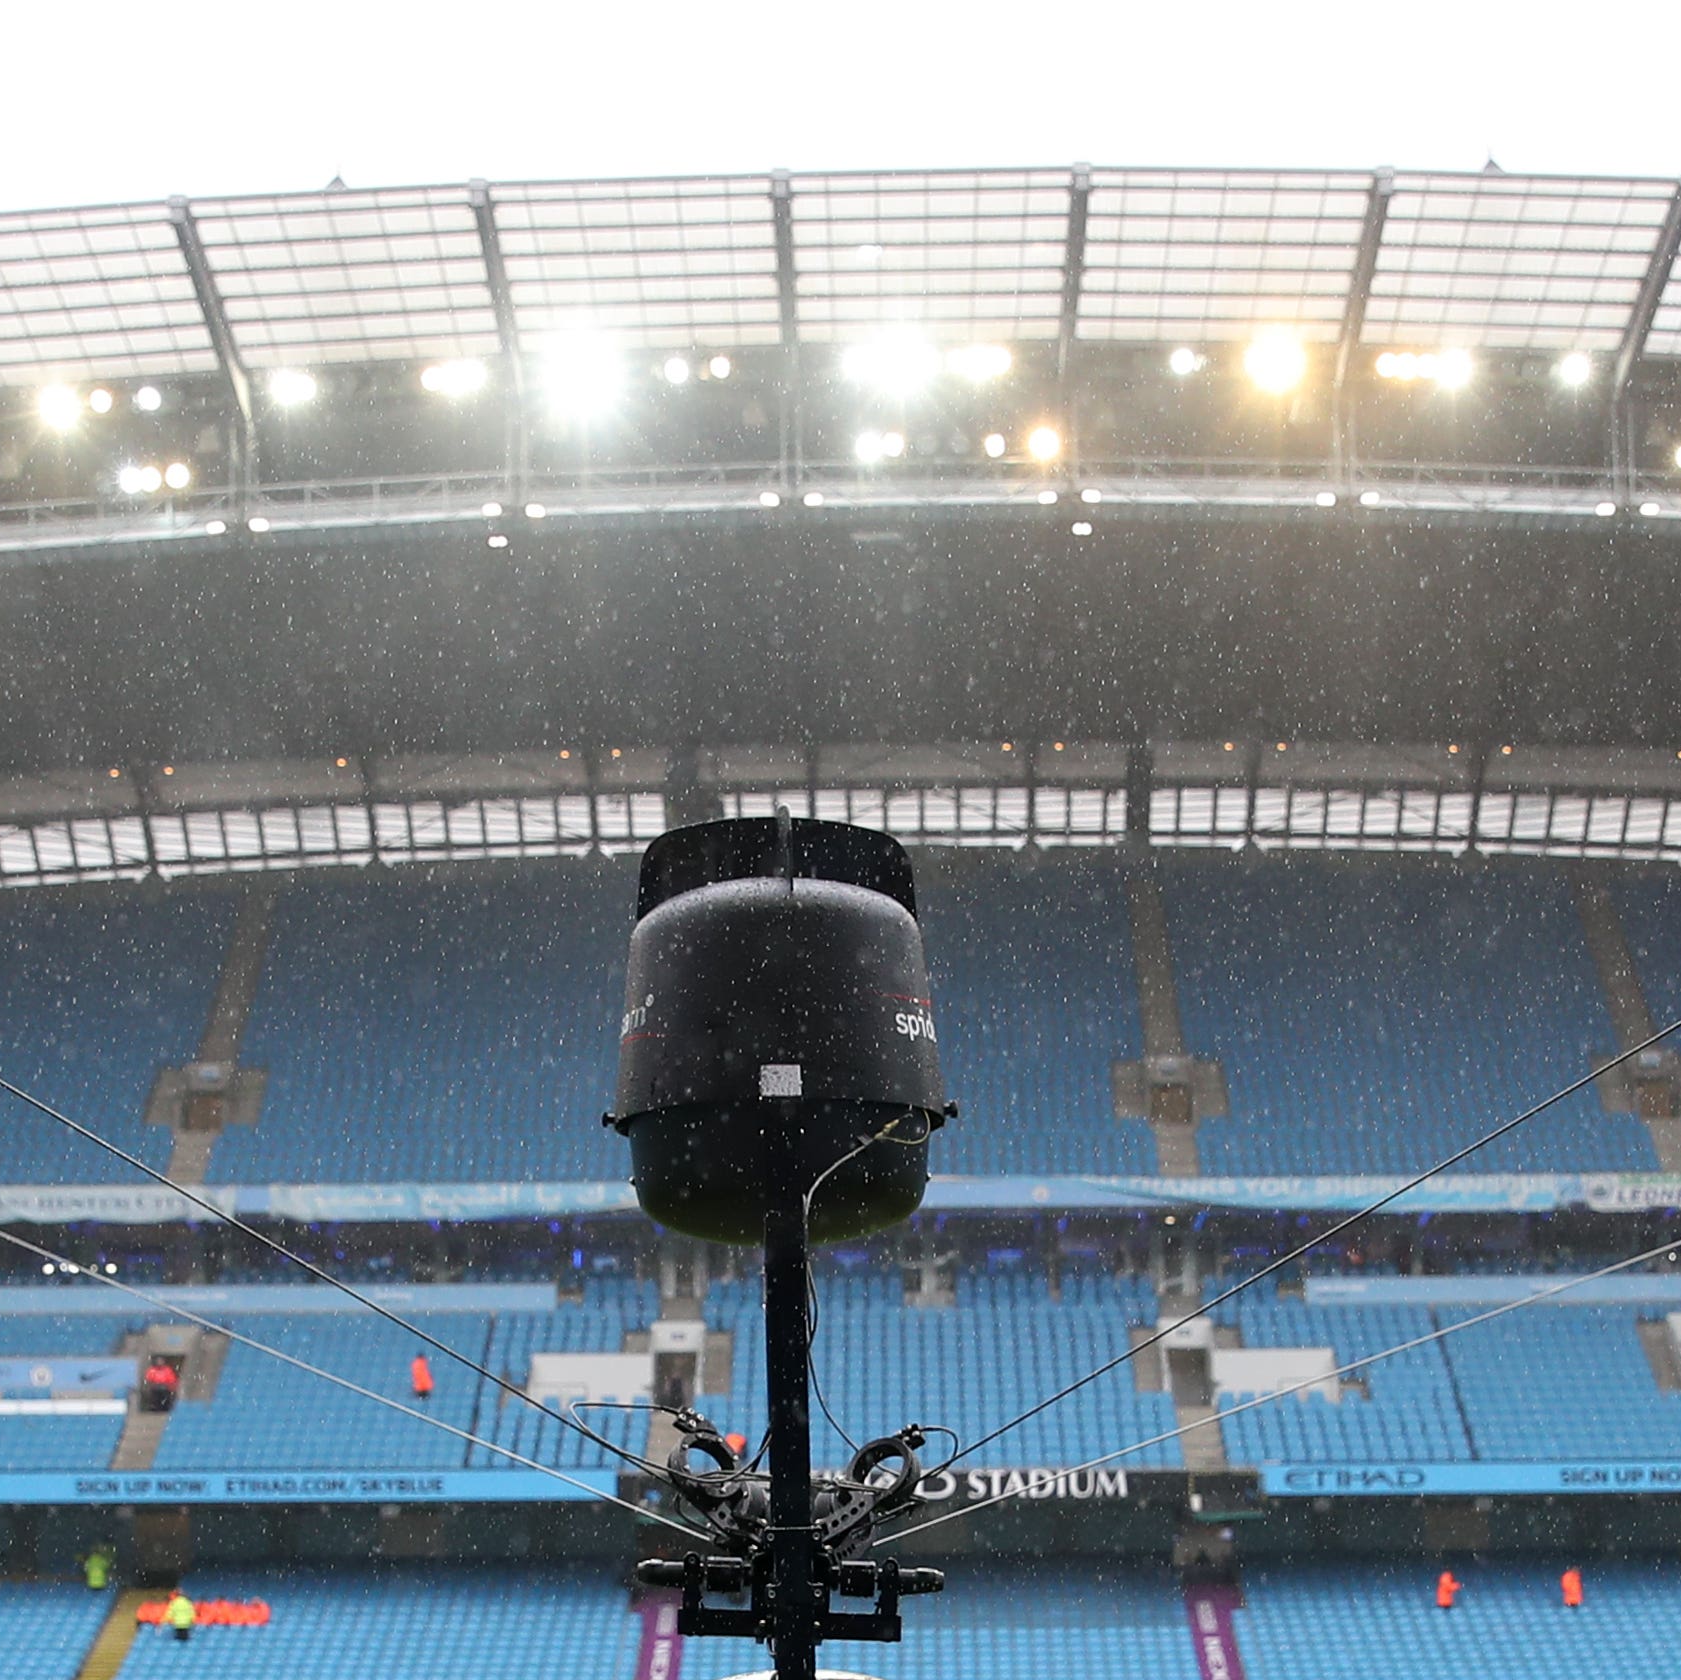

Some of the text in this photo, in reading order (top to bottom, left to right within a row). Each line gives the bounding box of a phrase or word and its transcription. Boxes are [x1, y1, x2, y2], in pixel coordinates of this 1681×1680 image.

[967, 1468, 1129, 1500] STADIUM
[1283, 1468, 1425, 1490] ETIHAD
[1560, 1468, 1608, 1486] SIGN
[1615, 1468, 1644, 1485] UP
[123, 1479, 153, 1496] UP
